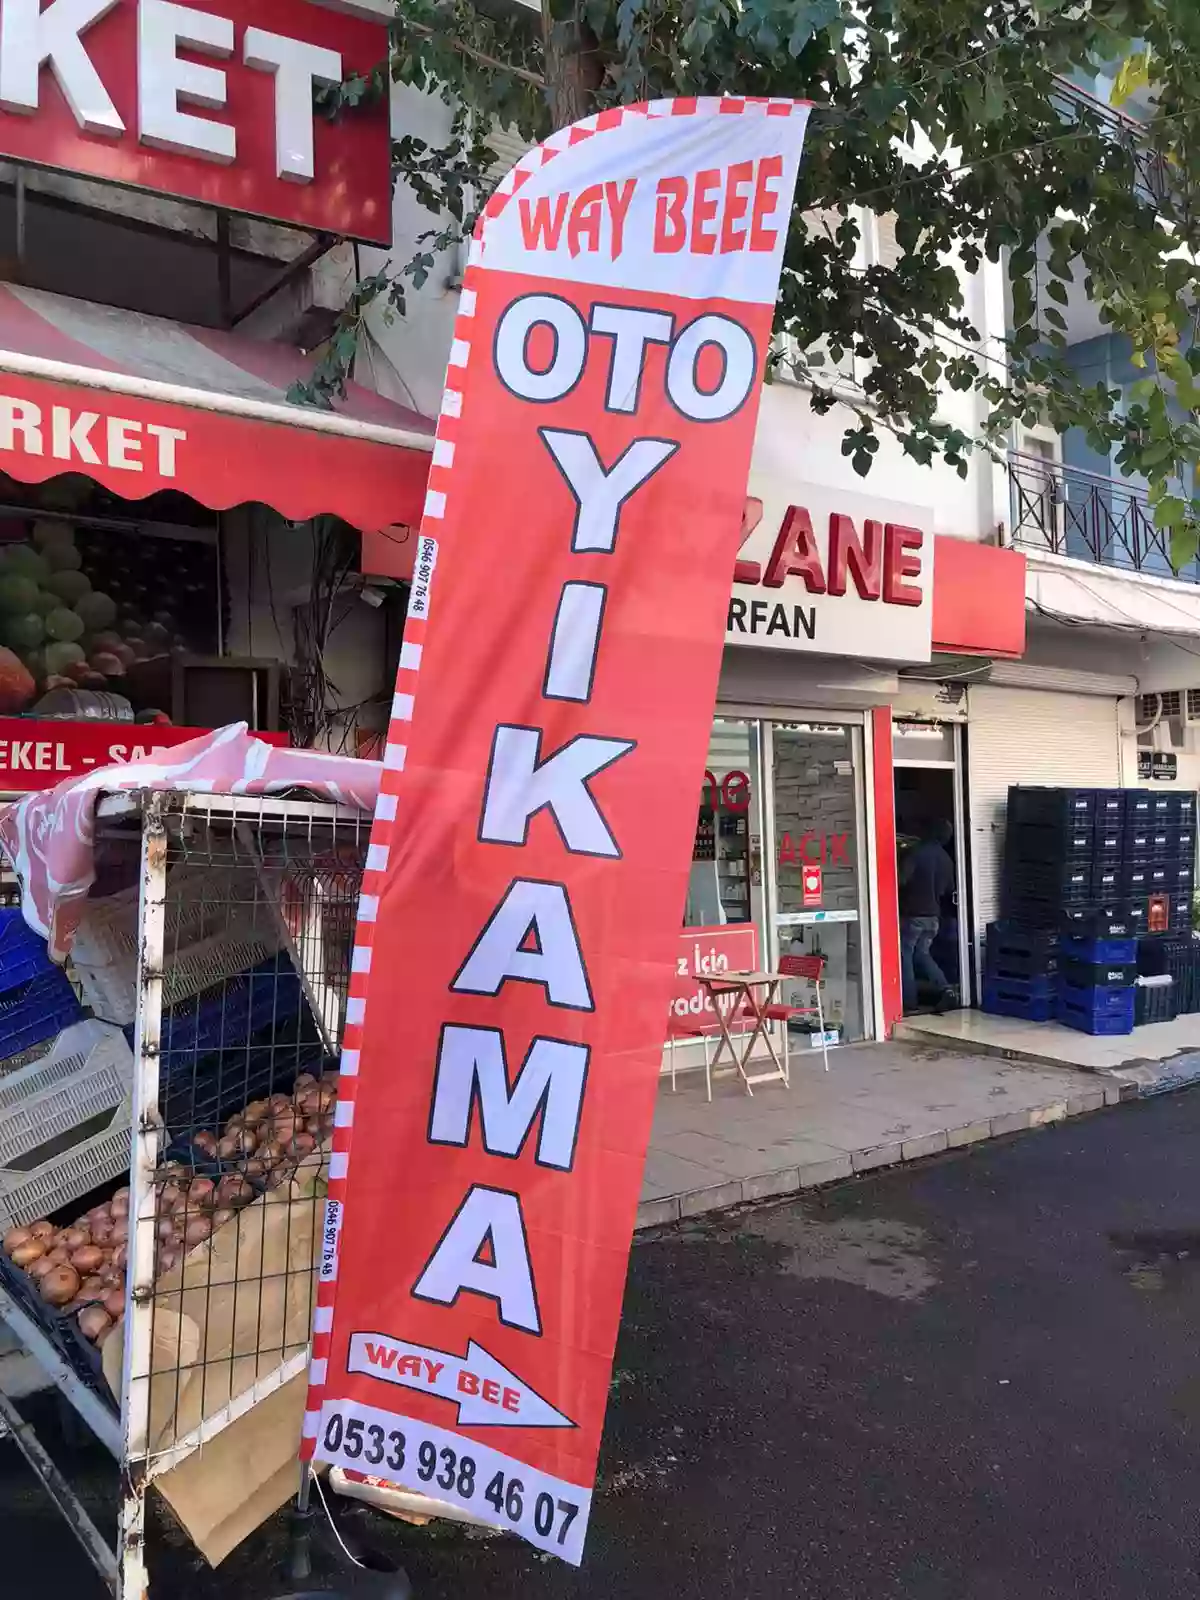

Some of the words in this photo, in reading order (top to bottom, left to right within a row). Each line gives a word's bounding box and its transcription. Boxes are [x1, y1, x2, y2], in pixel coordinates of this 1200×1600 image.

[0, 0, 342, 184] KET
[519, 178, 639, 263] WAY
[653, 155, 782, 255] BEEE
[493, 292, 757, 423] OTO
[0, 395, 187, 477] RKET
[421, 538, 435, 562] 0546
[418, 564, 431, 584] 907
[415, 585, 428, 597] 76
[413, 599, 425, 612] 48
[410, 427, 681, 1337] YIKAMA
[327, 1201, 339, 1225] 0546
[325, 1227, 336, 1245] 907
[323, 1247, 334, 1261] 76
[322, 1262, 333, 1275] 48
[364, 1343, 445, 1383] WAY
[457, 1369, 521, 1413] BEE
[324, 1413, 406, 1470] 0533
[417, 1441, 476, 1498] 938
[485, 1470, 524, 1522] 46
[534, 1492, 579, 1545] 07
